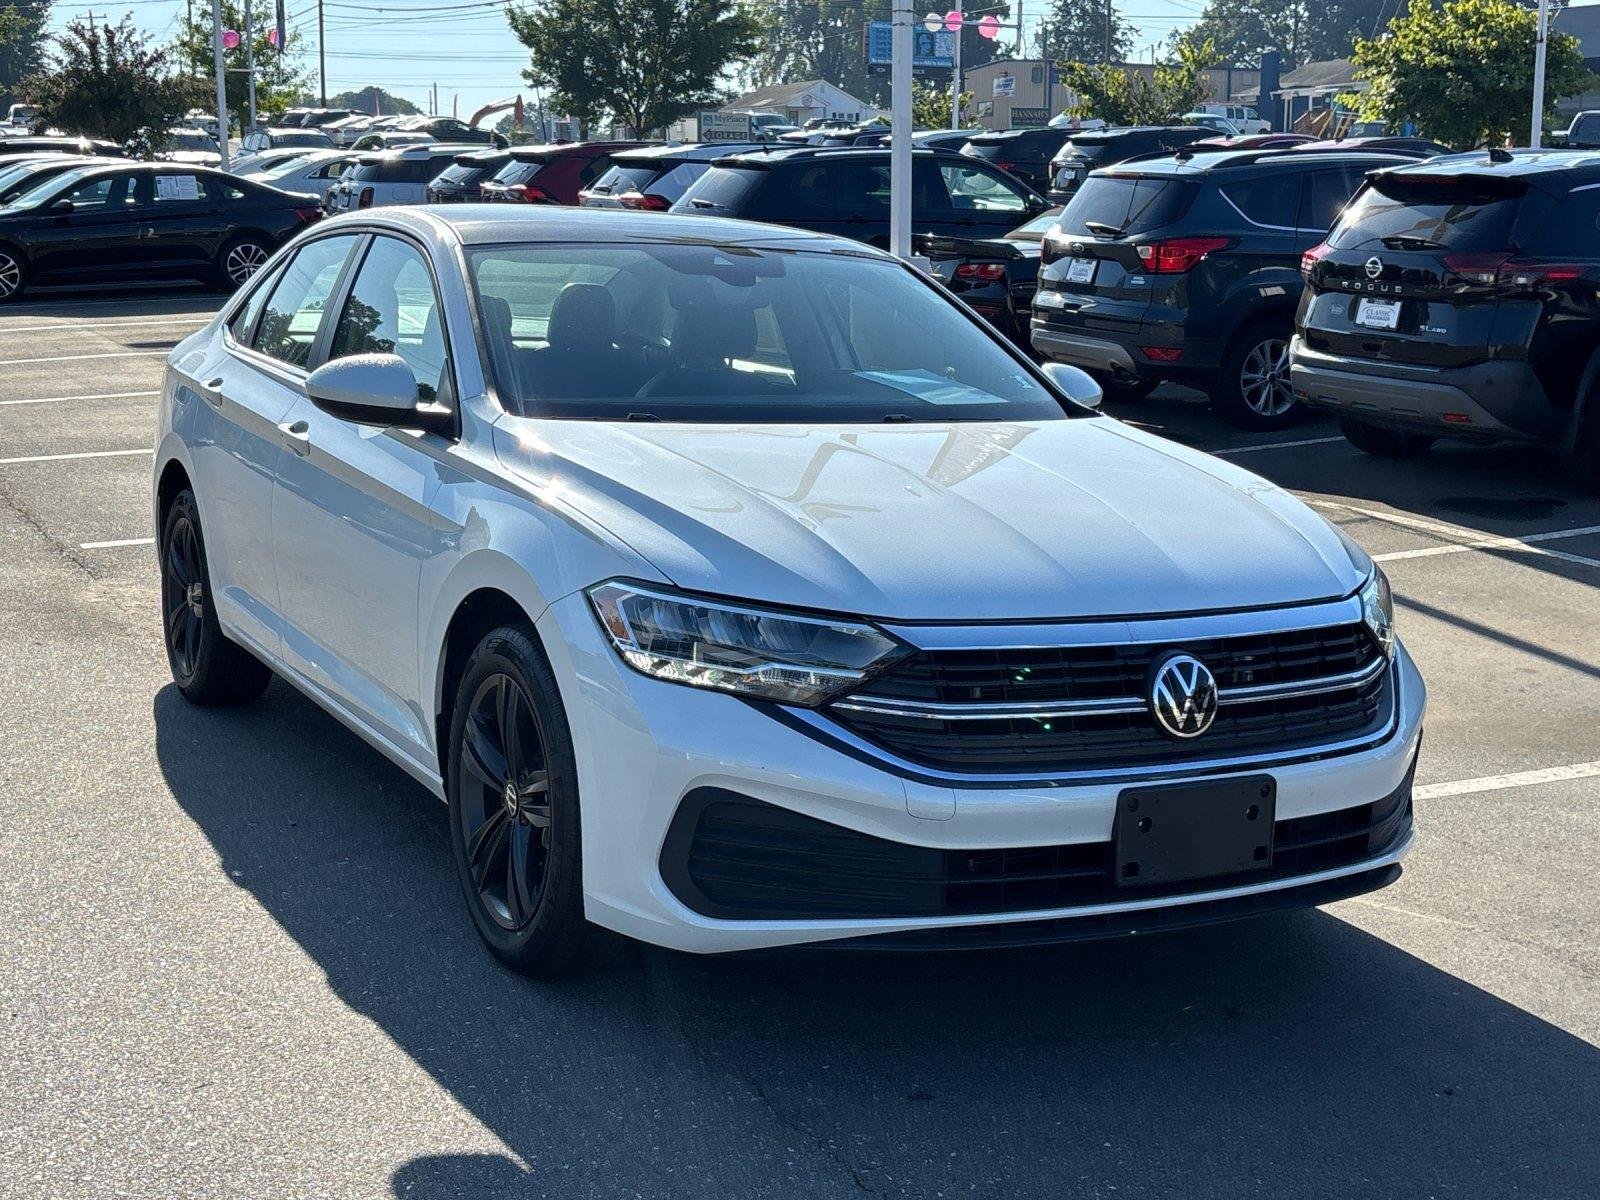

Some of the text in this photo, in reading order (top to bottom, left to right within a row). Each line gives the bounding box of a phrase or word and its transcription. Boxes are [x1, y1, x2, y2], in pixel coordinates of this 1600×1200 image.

[714, 113, 747, 124] MyPlace
[706, 131, 747, 139] STORAGE
[1341, 281, 1402, 293] ROGUE
[1366, 308, 1391, 317] CLASSIC
